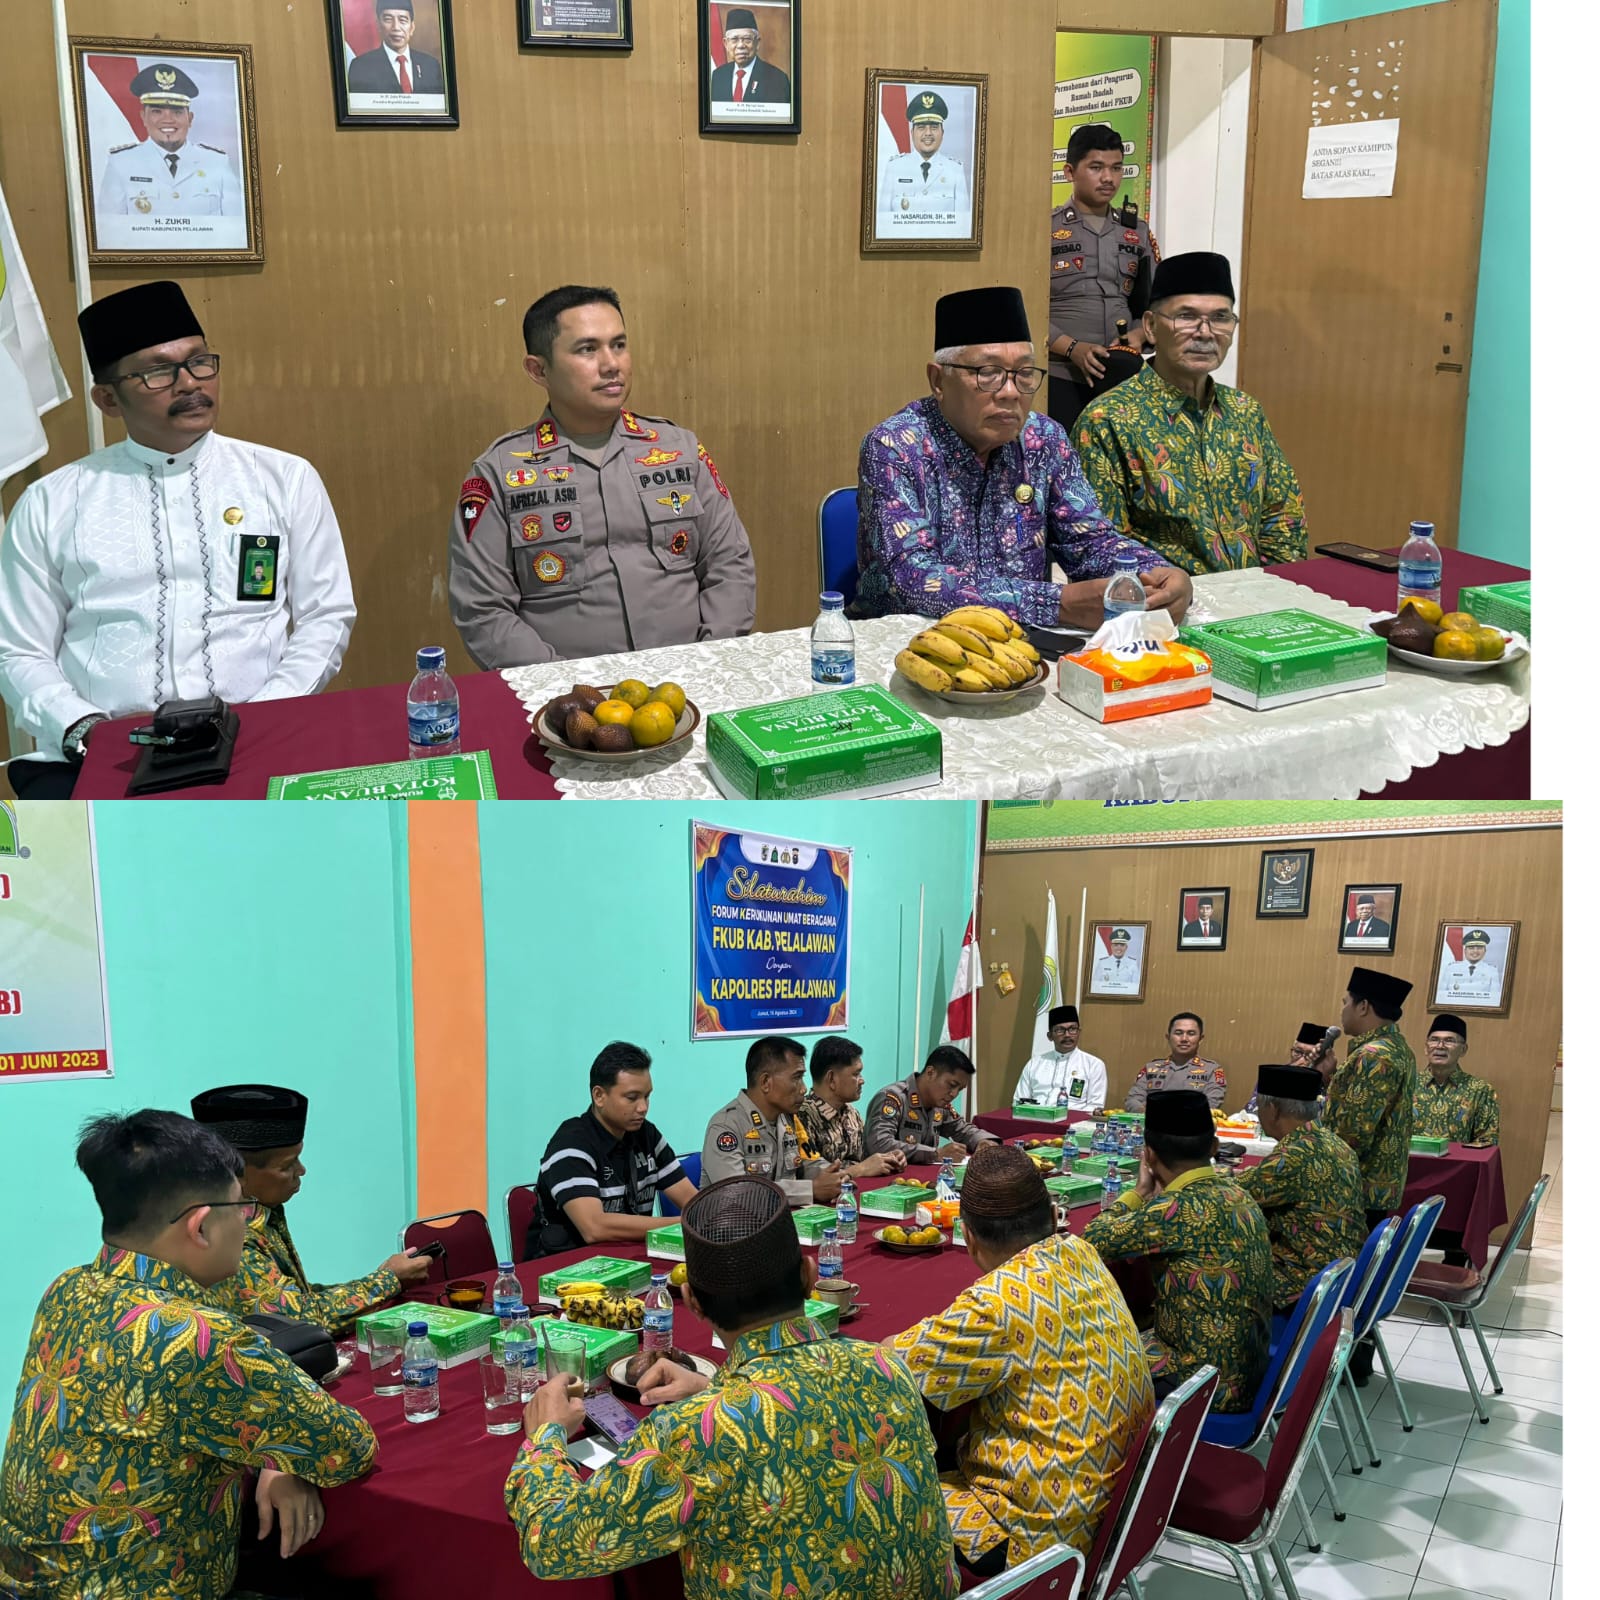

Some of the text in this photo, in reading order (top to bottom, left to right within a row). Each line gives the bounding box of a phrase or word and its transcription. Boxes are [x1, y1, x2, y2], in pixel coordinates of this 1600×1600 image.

[1090, 77, 1103, 87] dari
[1104, 73, 1134, 84] Pengurus
[1093, 87, 1113, 98] Ibadah
[1101, 99, 1113, 108] dari
[1114, 96, 1133, 106] FKUB
[1313, 143, 1393, 156] ANDA SOPAN KAMIPUN
[1310, 170, 1333, 180] BATAS
[1334, 169, 1351, 178] ALAS
[639, 466, 691, 489] POLRI
[510, 486, 577, 510] AFRIZAL ASRI
[760, 705, 880, 733] KOTA BUANA
[394, 776, 456, 791] KOTA
[304, 785, 386, 800] BUANA
[726, 865, 828, 906] Silaturahim
[711, 905, 837, 927] FORUM KERUKUNAN UMAT BERAGAMA
[712, 926, 836, 953] FKUB KAB. PELALAWAN
[711, 978, 836, 1000] KAPOLRES PELALAWAN
[0, 1051, 100, 1071] 01 JUNI 2023
[783, 1139, 798, 1148] POL
